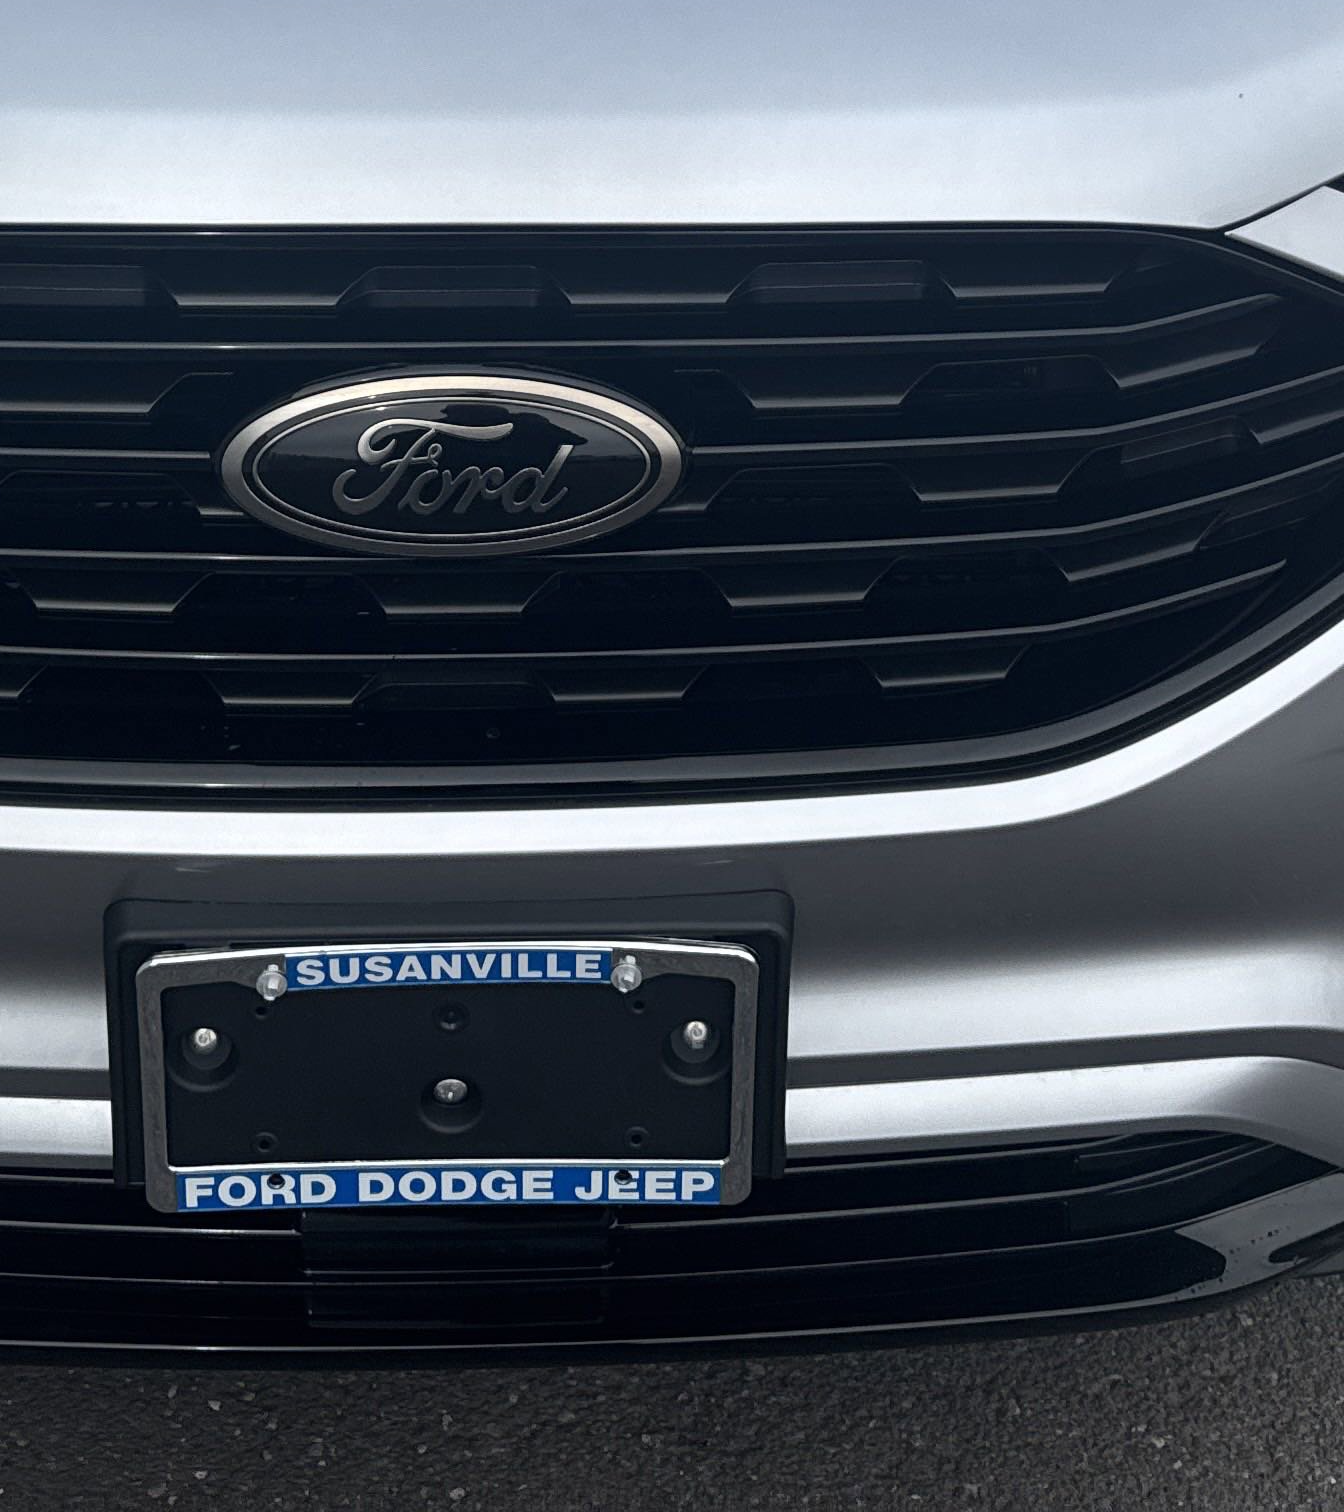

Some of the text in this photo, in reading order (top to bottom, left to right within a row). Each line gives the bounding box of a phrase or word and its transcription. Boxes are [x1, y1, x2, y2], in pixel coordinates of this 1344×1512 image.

[332, 417, 575, 515] Ford
[296, 953, 602, 986] SUSANVILLE
[184, 1169, 716, 1208] FORD DODGE JEEP
